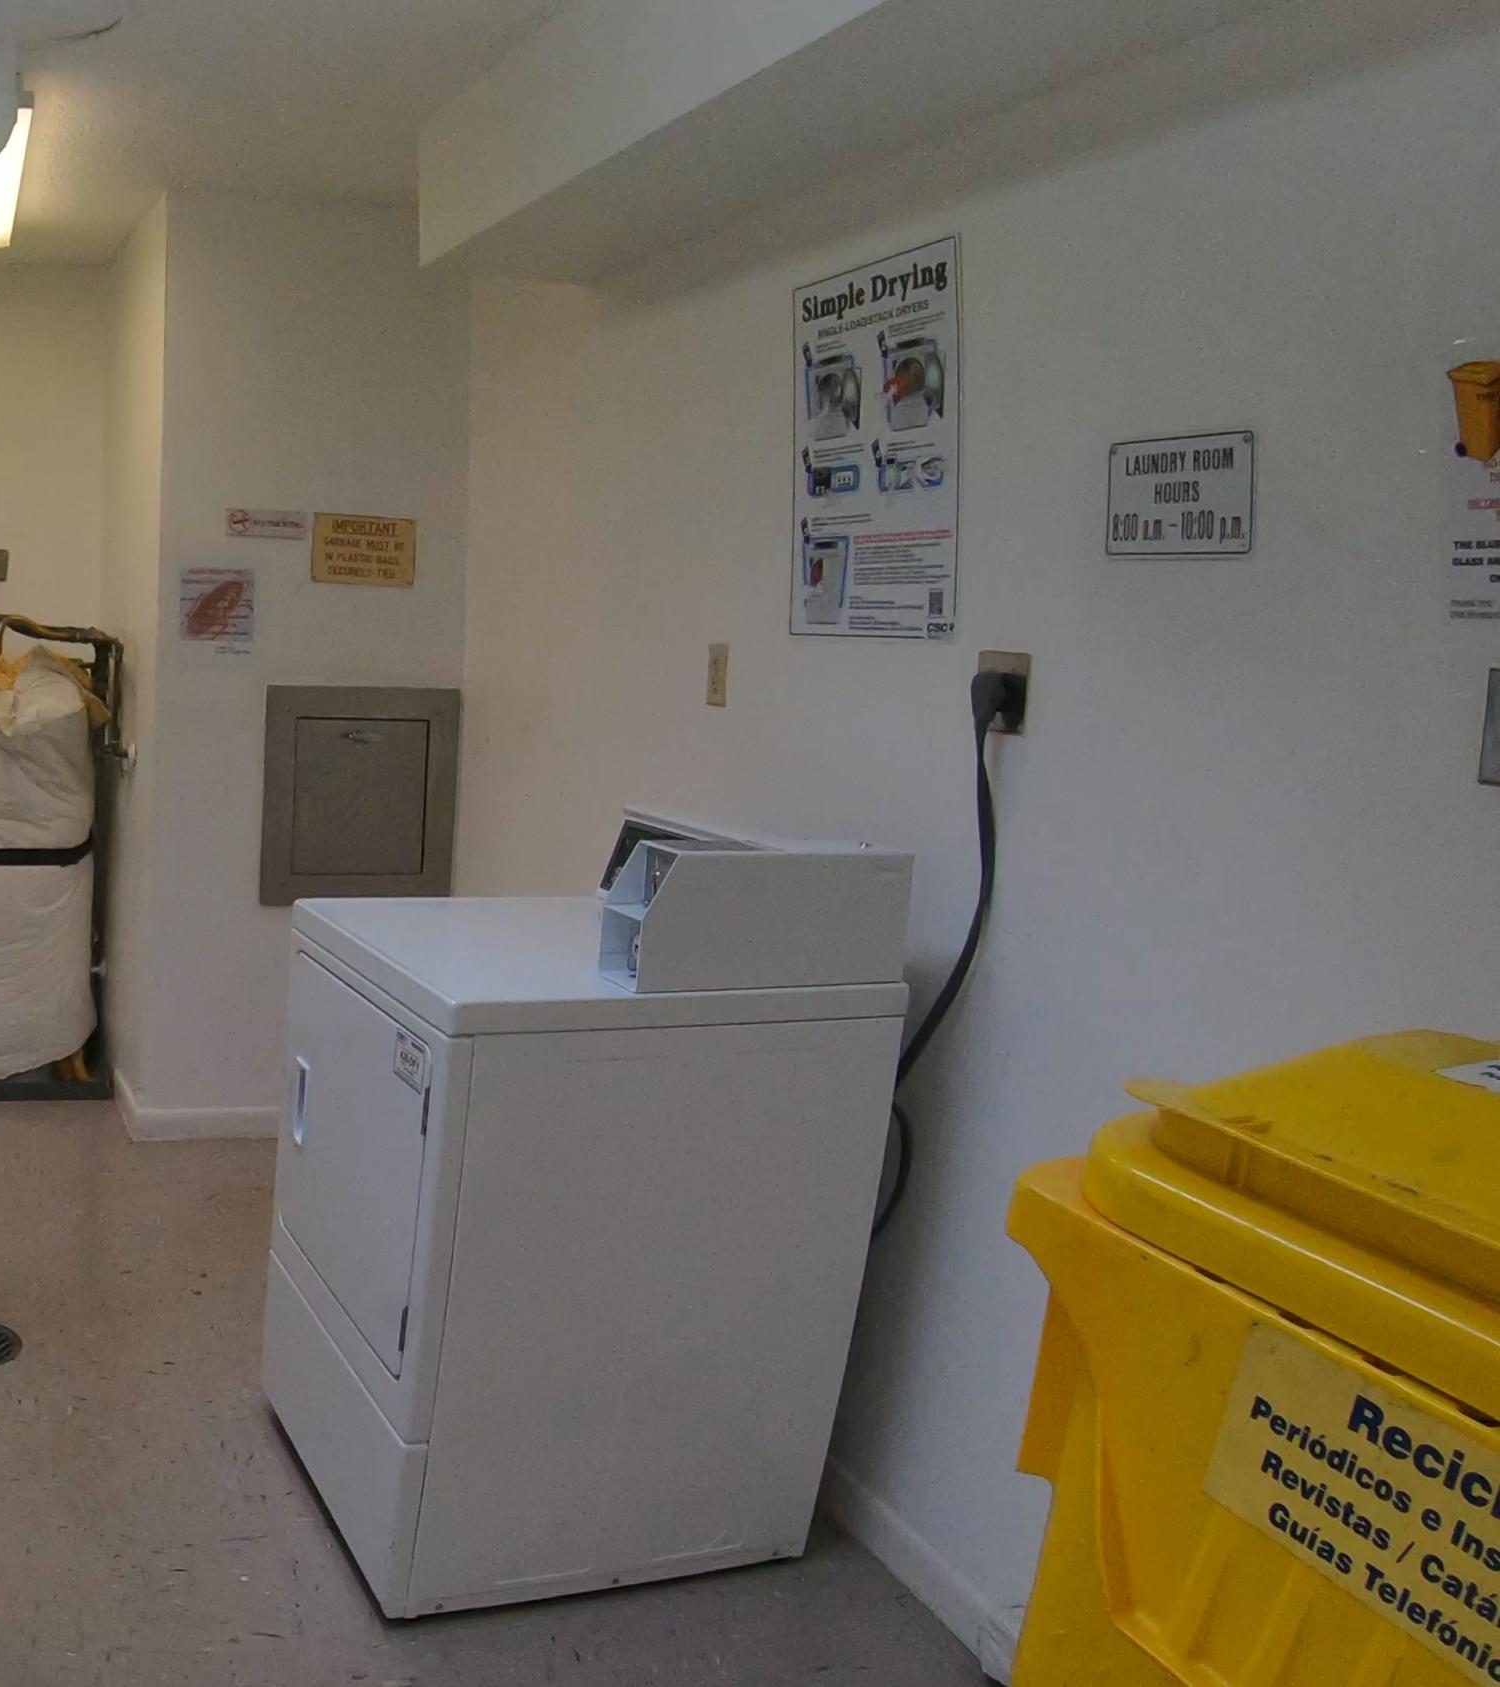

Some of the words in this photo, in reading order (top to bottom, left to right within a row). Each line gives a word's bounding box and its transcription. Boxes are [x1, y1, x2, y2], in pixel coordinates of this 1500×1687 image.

[802, 281, 866, 323] Simple
[870, 261, 948, 303] Drying
[895, 299, 930, 318] DRYERS
[1125, 451, 1187, 477] LAUNDRY
[1192, 447, 1235, 472] ROOM
[1153, 481, 1201, 505] HOURS
[331, 519, 399, 537] IMPORTANT
[1112, 513, 1139, 542] 8:00
[1142, 518, 1165, 541] a.m.
[1181, 510, 1215, 541] 10:00
[1219, 516, 1245, 545] p.m.
[337, 552, 373, 564] PLASTIC
[1250, 1395, 1412, 1514] Periódicos
[1421, 1508, 1442, 1532] e
[1260, 1449, 1391, 1550] Revistas
[1396, 1541, 1415, 1563] /
[1420, 1554, 1500, 1629] Catá
[1268, 1502, 1353, 1574] Guías
